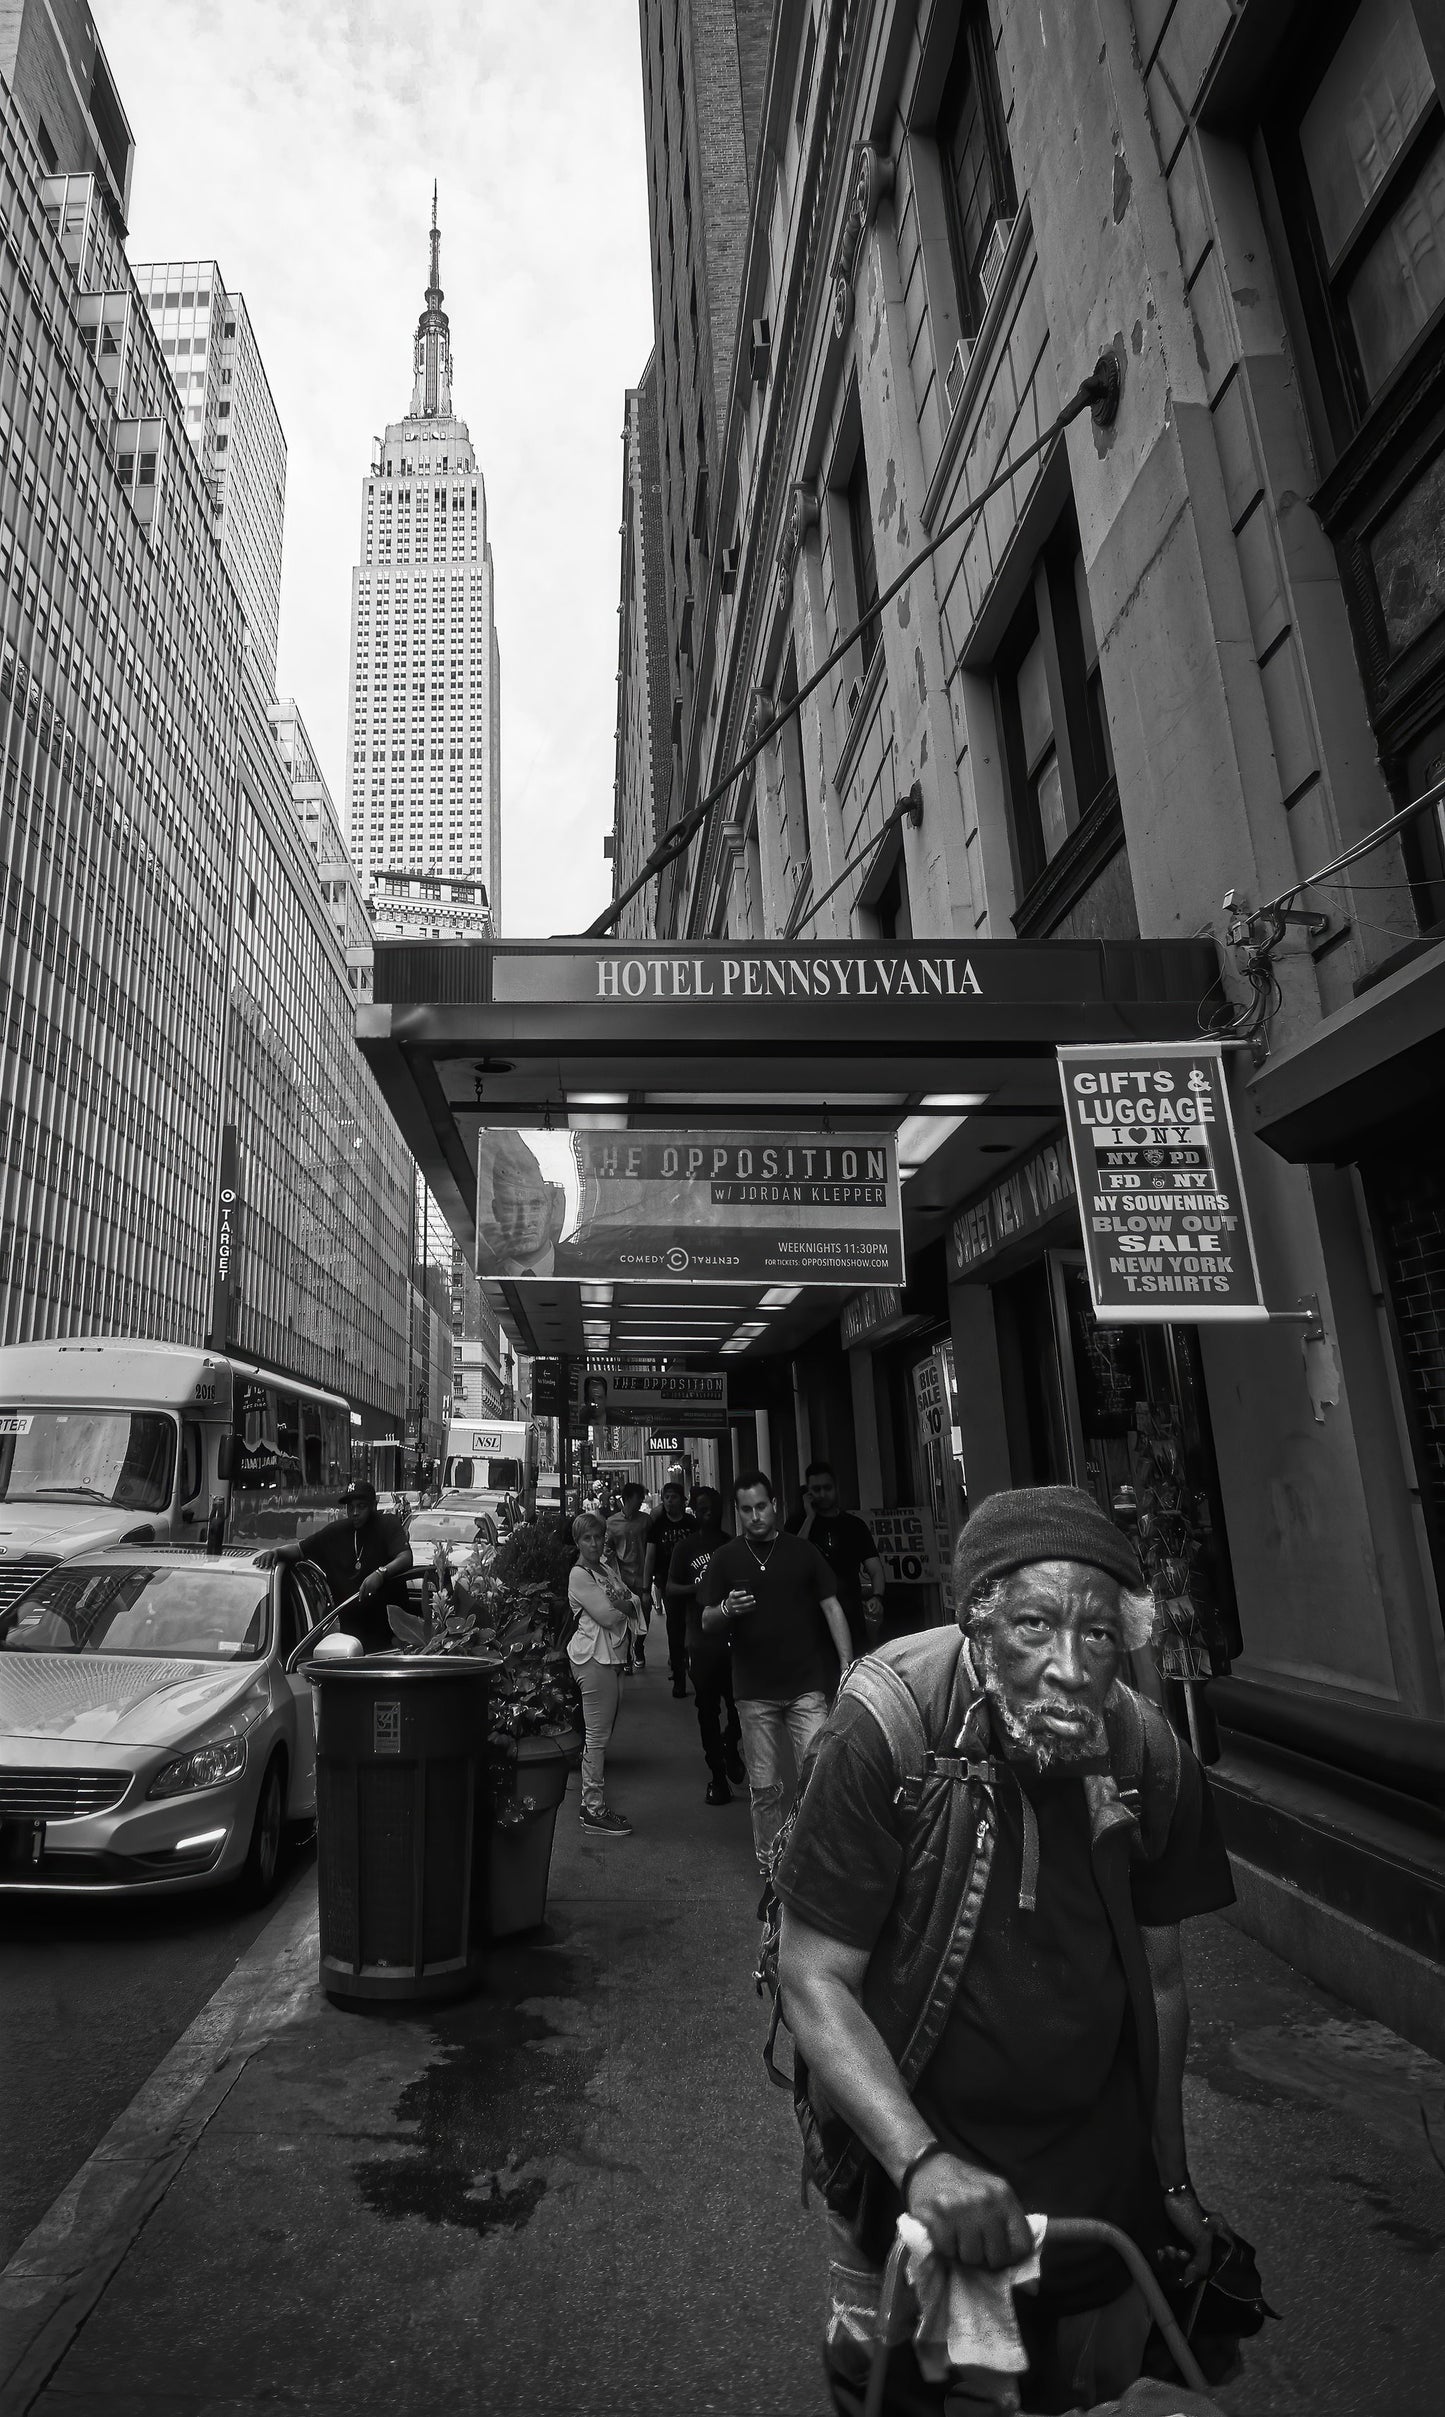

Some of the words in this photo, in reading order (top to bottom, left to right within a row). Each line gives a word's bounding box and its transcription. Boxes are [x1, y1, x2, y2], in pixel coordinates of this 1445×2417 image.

[596, 959, 714, 997] HOTEL
[721, 958, 983, 996] PENNSYLVANIA
[1073, 1070, 1175, 1094] GIFTS
[1187, 1069, 1212, 1092] &
[1077, 1097, 1216, 1125] LUGGAGE
[1111, 1128, 1123, 1144] I
[594, 1147, 642, 1177] HE
[660, 1147, 884, 1180] OPPOSITION
[1106, 1152, 1138, 1165] NY
[1169, 1150, 1200, 1165] PD
[1108, 1174, 1142, 1189] FD
[1172, 1173, 1208, 1188] NY
[740, 1186, 802, 1201] JORDAN
[812, 1187, 883, 1202] KLEPPER
[952, 1197, 993, 1268] SWEET
[991, 1172, 1025, 1241] NEW
[1024, 1135, 1077, 1217] YORK
[1093, 1195, 1118, 1212] NY
[1121, 1194, 1231, 1211] SOUVENIRS
[1091, 1215, 1173, 1232] BLOW
[1181, 1215, 1239, 1232] OUT
[218, 1208, 232, 1282] TARGET
[778, 1242, 842, 1254] WEEKNIGHTS
[844, 1243, 889, 1255] 11:30PM
[1117, 1234, 1222, 1253] SALE
[619, 1254, 665, 1264] COMEDY
[691, 1255, 741, 1266] CENTRAL
[801, 1258, 889, 1268] OPPOSITIONSHOW.COM
[1109, 1256, 1163, 1273] NEW
[1167, 1256, 1234, 1273] YORK
[1122, 1275, 1231, 1293] T.SHIRTS
[614, 1377, 637, 1389] THE
[643, 1377, 723, 1391] OPPOSITION
[919, 1366, 939, 1391] BIG
[194, 1383, 217, 1400] 2018
[917, 1385, 942, 1412] SALE
[475, 1436, 500, 1449] NSL
[649, 1437, 679, 1450] NAILS
[875, 1517, 924, 1536] BIG
[876, 1535, 925, 1554] ALE
[884, 1554, 923, 1581] 10
